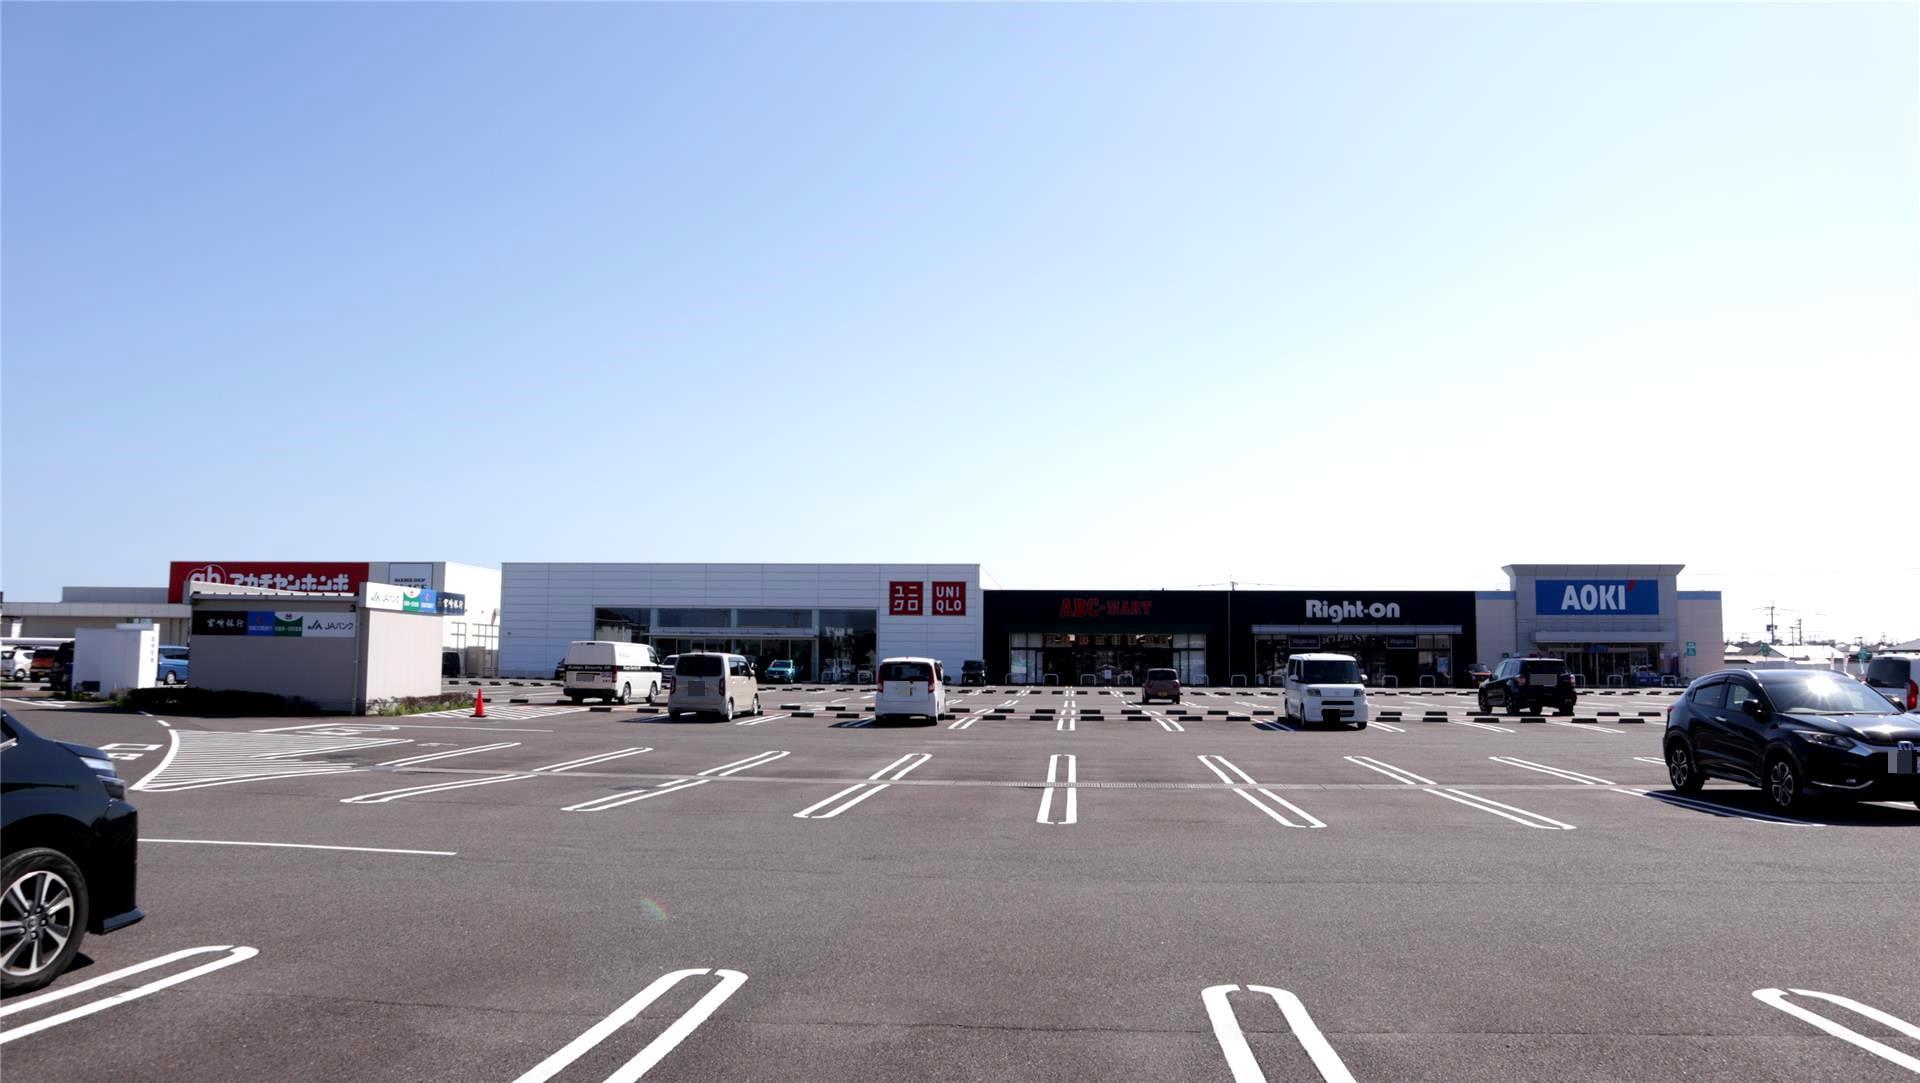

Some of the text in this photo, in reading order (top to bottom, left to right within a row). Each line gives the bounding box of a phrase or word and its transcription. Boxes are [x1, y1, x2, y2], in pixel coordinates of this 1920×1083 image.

[935, 585, 960, 598] UNI
[1560, 583, 1627, 612] AOKI
[935, 599, 962, 613] QLO
[1305, 599, 1400, 623] Right-on
